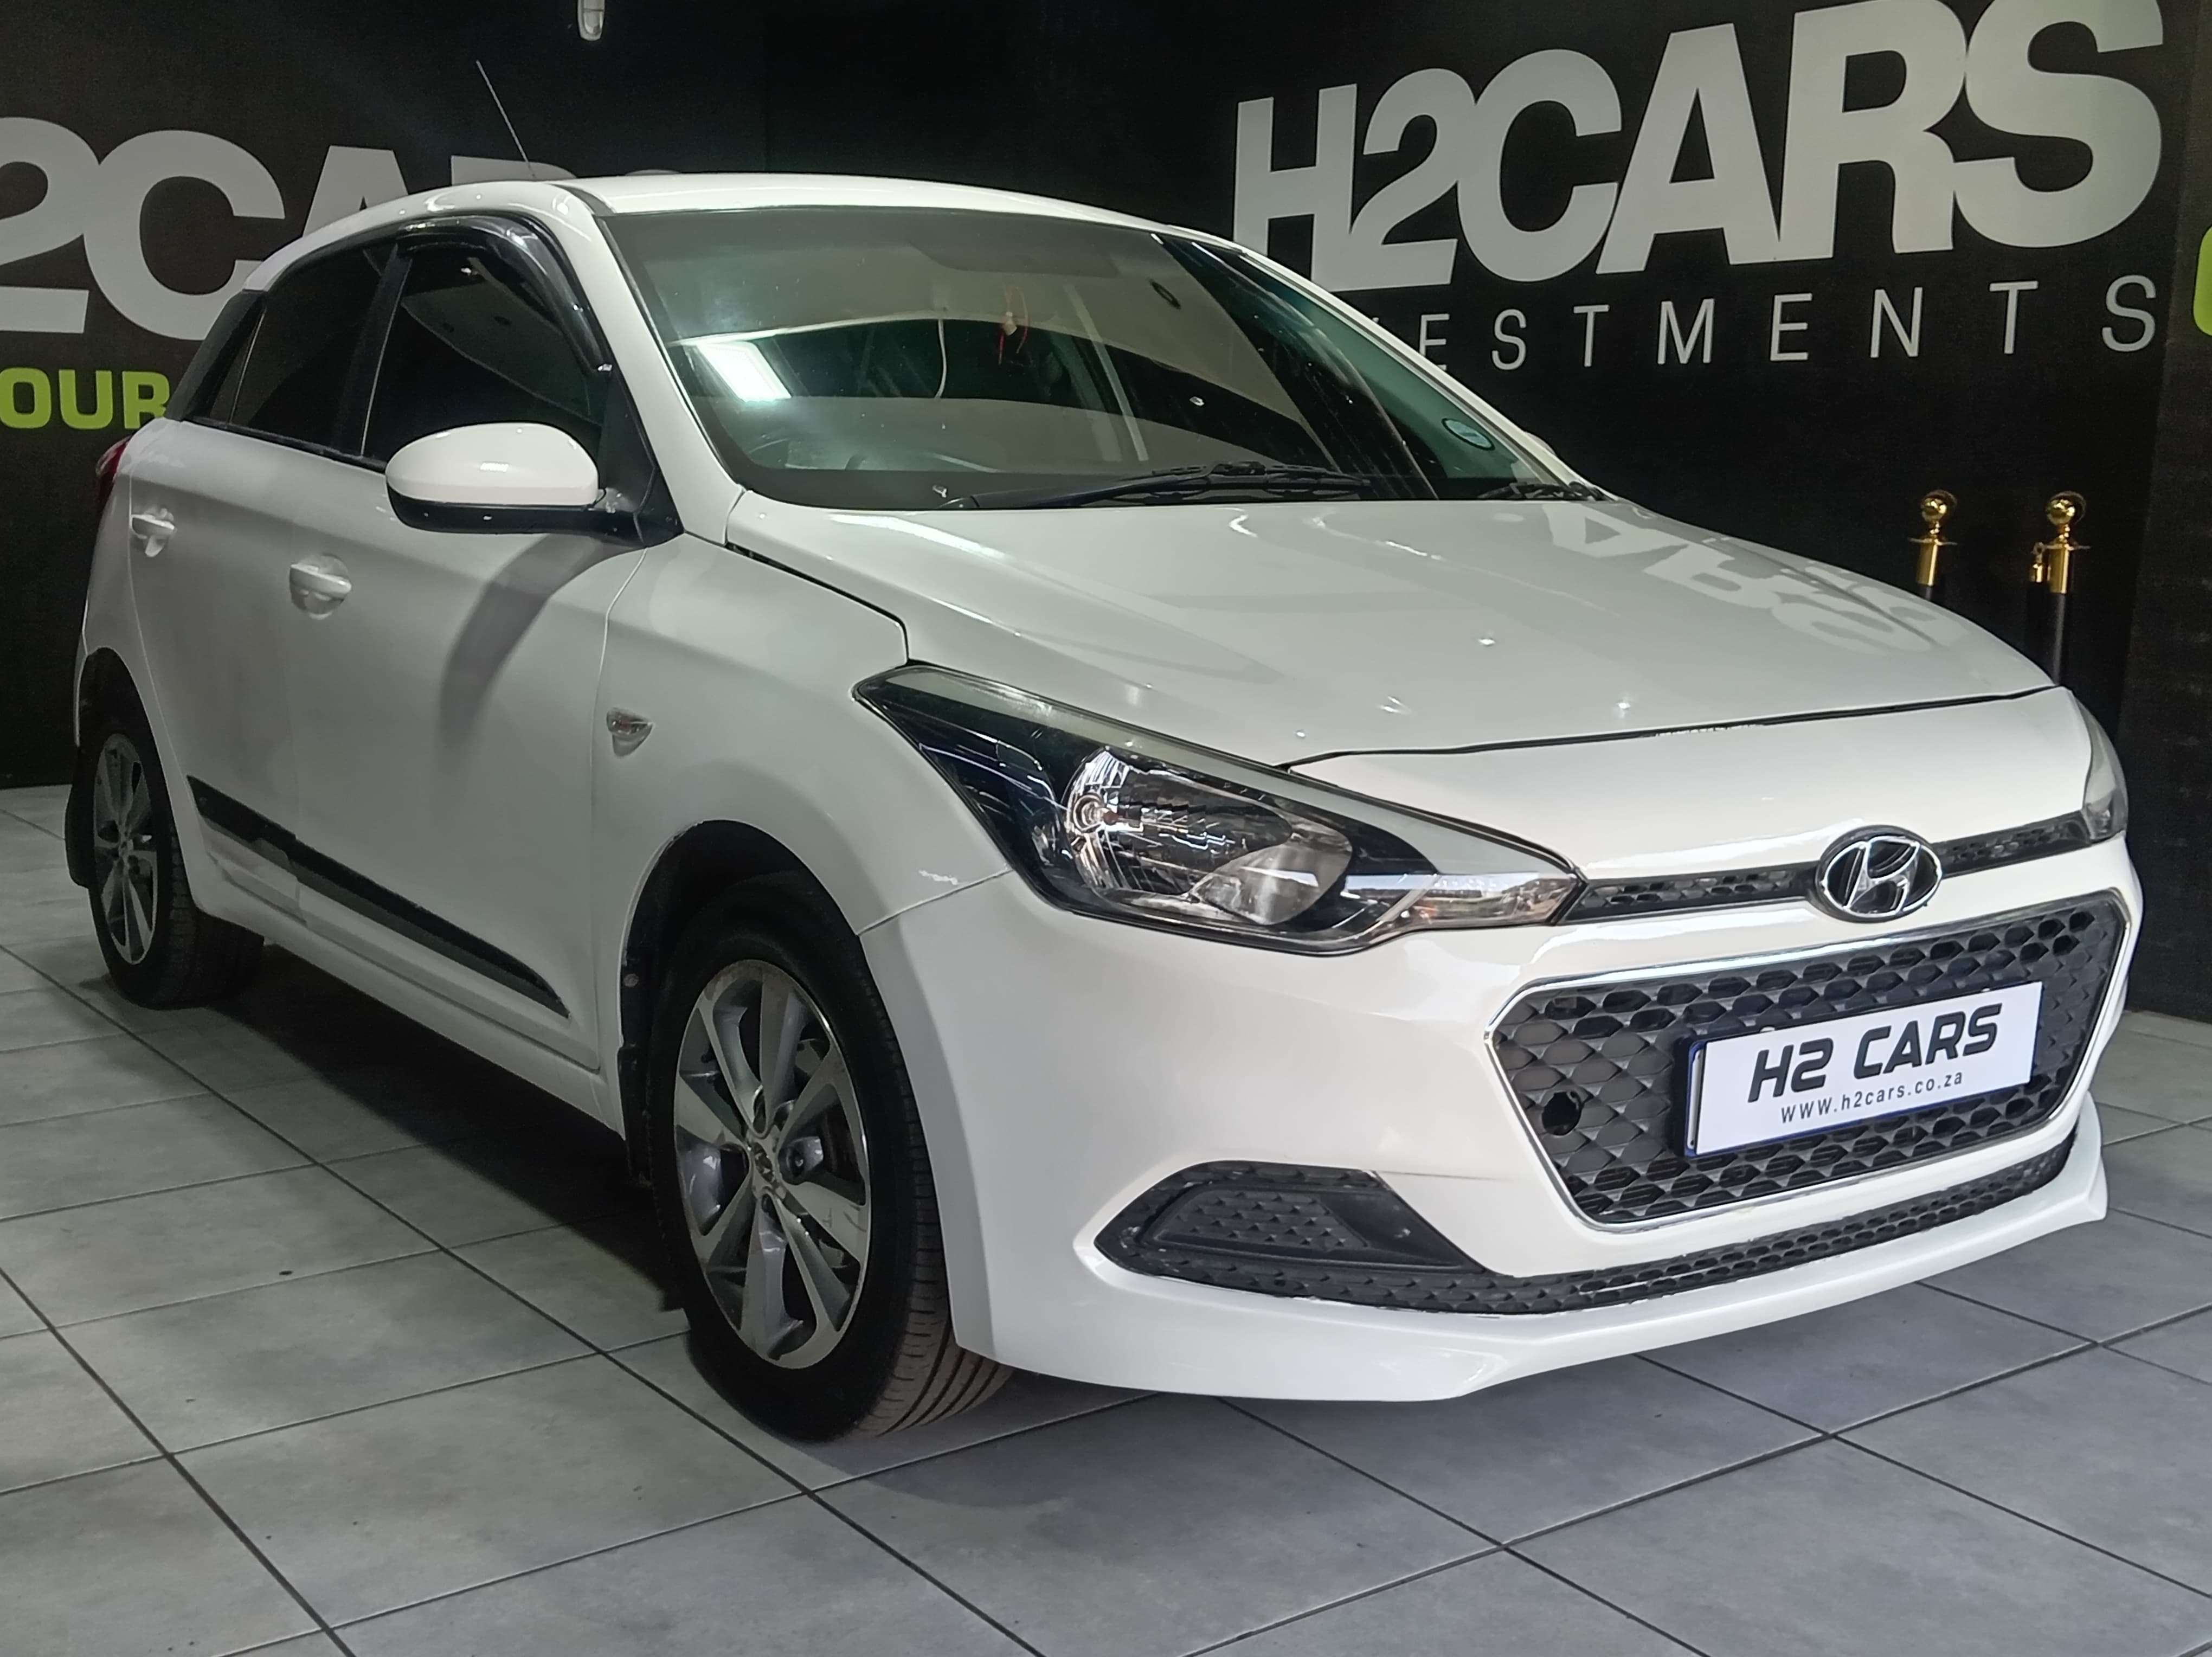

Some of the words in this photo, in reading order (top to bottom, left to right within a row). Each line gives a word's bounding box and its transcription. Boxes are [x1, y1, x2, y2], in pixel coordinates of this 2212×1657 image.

[1233, 0, 2163, 292] H2CARS
[1372, 274, 2156, 371] ESTMENTS
[1747, 1037, 1834, 1103] H2
[1853, 1003, 2002, 1080] CARS
